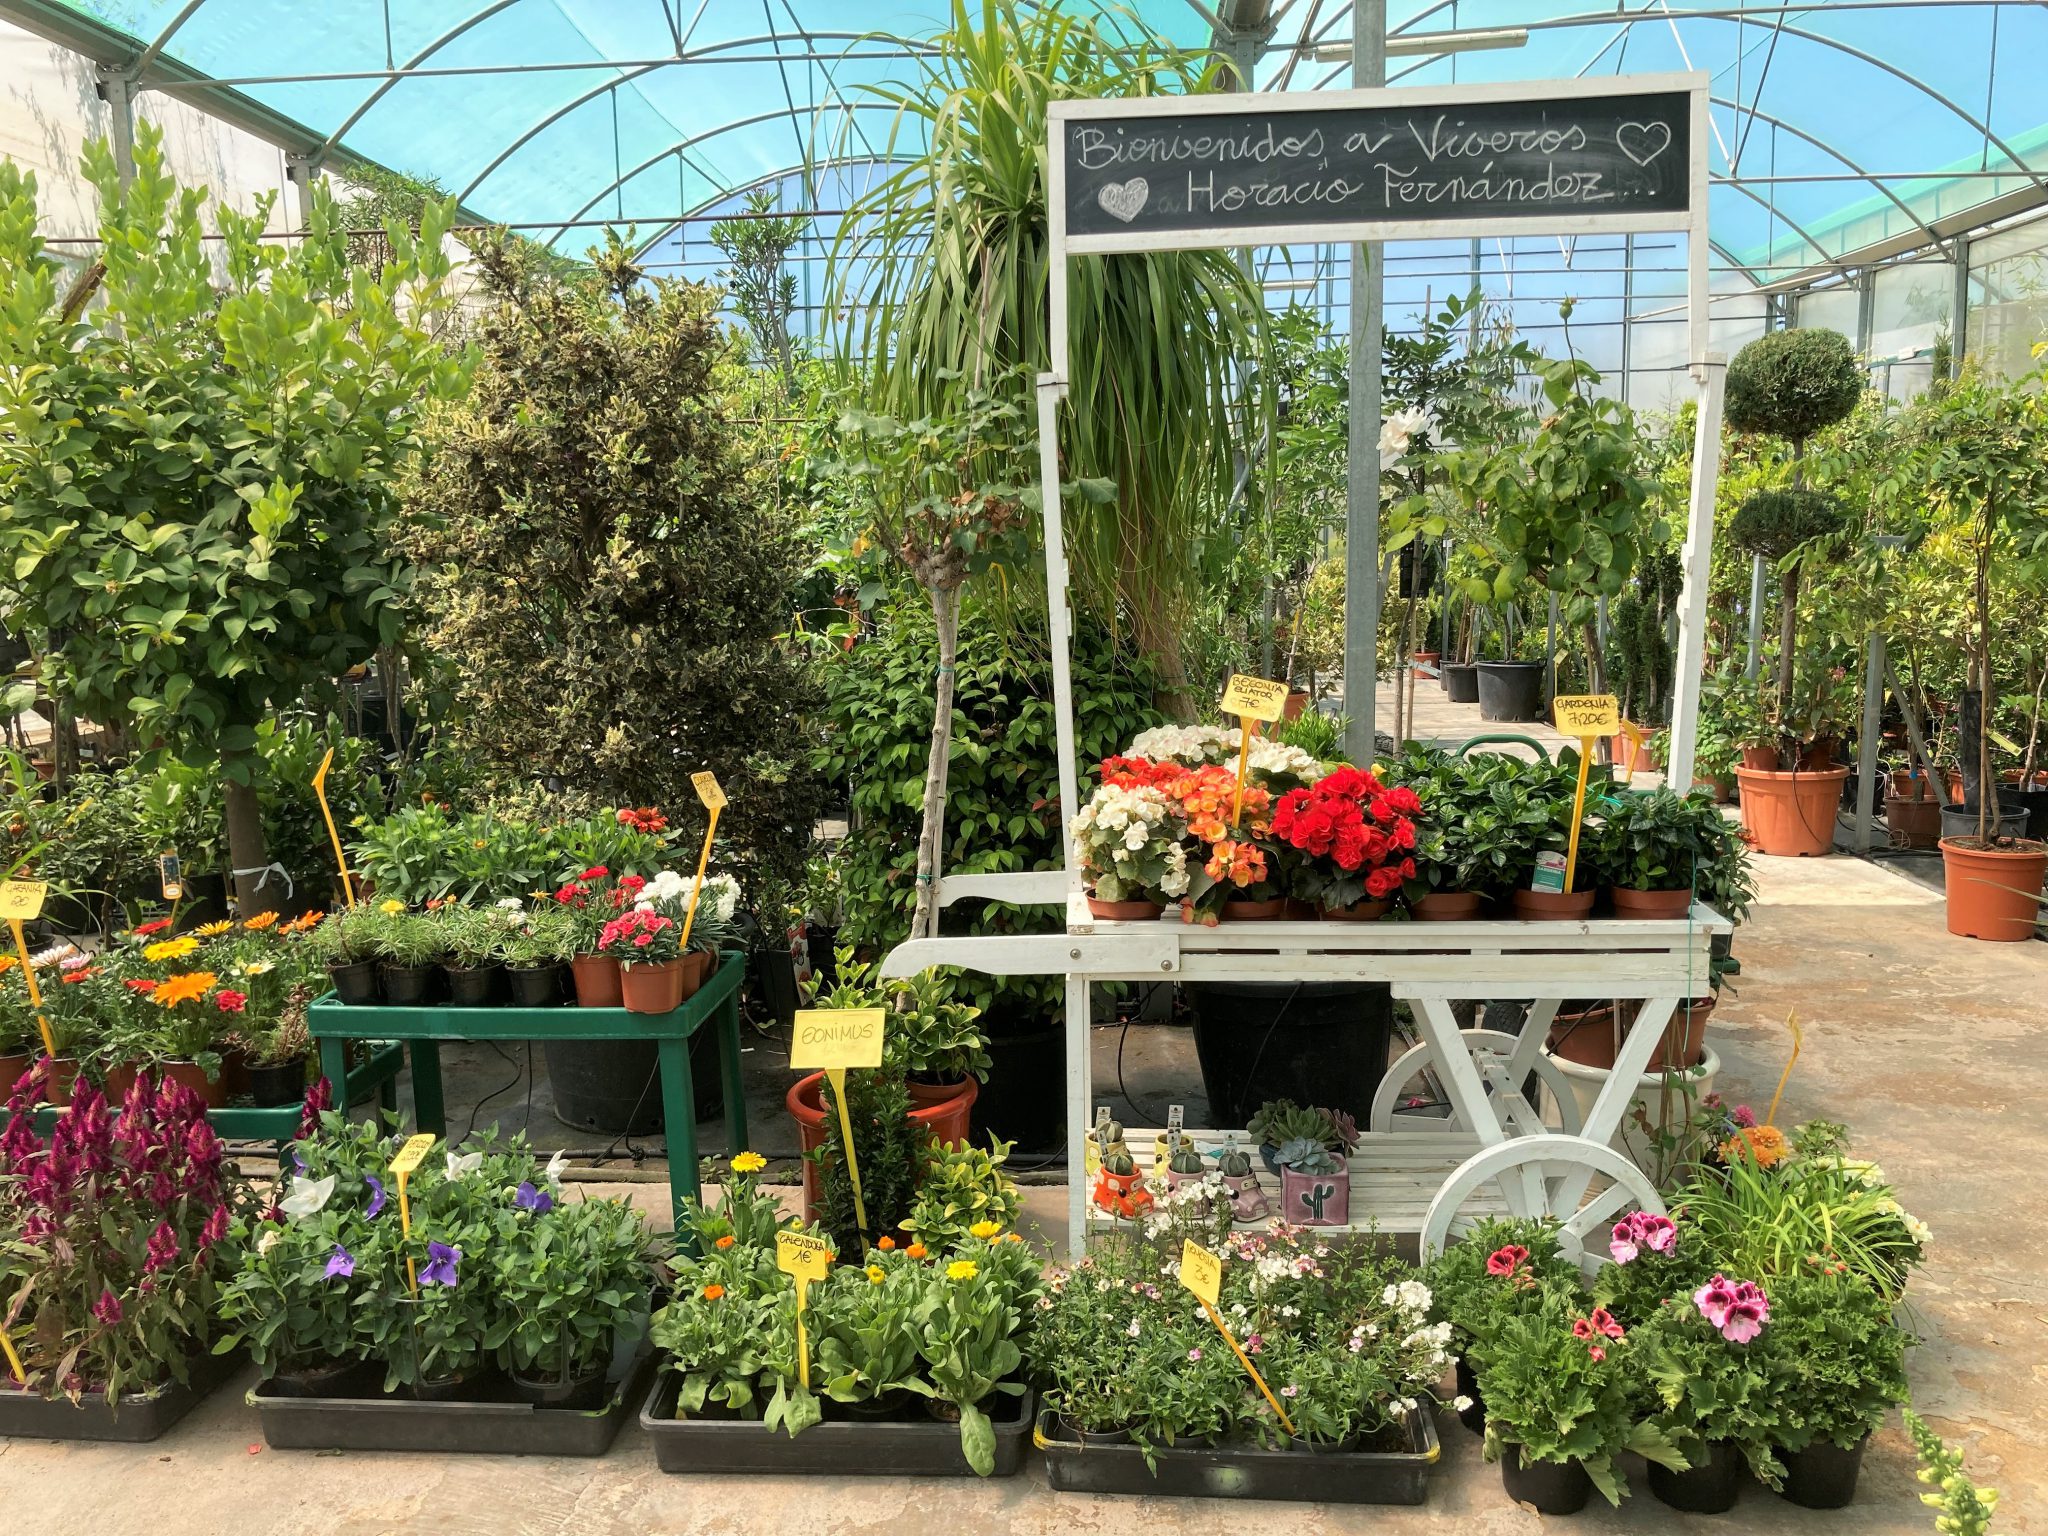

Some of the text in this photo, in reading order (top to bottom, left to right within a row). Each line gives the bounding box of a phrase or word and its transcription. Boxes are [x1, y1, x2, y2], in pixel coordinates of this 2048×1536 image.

[1073, 114, 1587, 169] Bienvenidos a Viveros
[1186, 168, 1365, 213] Horacio
